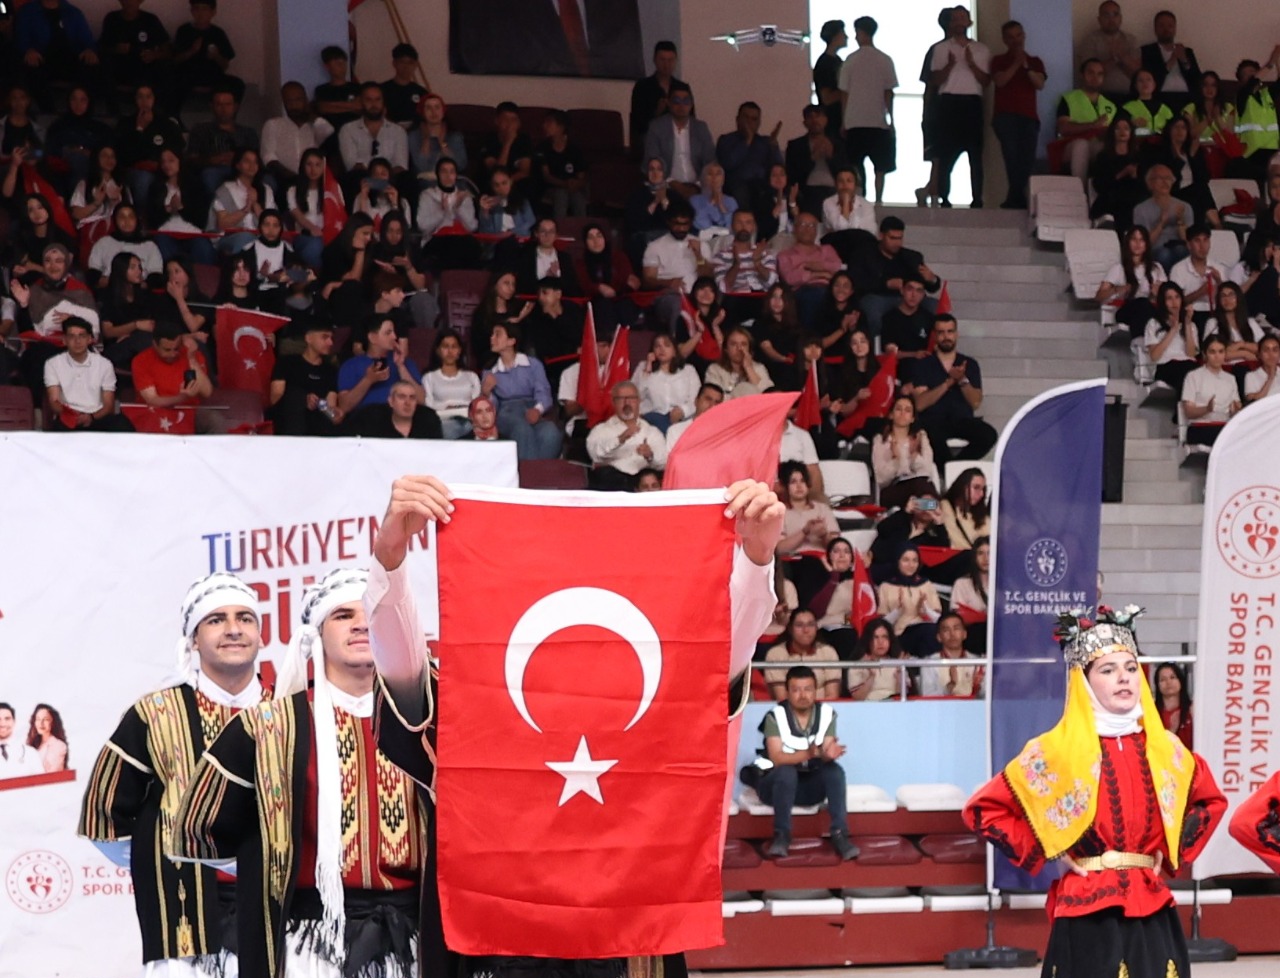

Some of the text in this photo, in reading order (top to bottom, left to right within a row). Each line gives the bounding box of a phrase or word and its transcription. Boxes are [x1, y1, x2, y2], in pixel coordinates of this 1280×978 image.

[1004, 590, 1087, 604] T.C. GENÇLİK VE
[1004, 604, 1032, 615] SPOR
[1256, 593, 1276, 636] T.C.
[1222, 592, 1249, 793] SPOR BAKANLIĞI
[1247, 644, 1273, 753] GENÇLİK
[82, 883, 124, 896] SPOR
